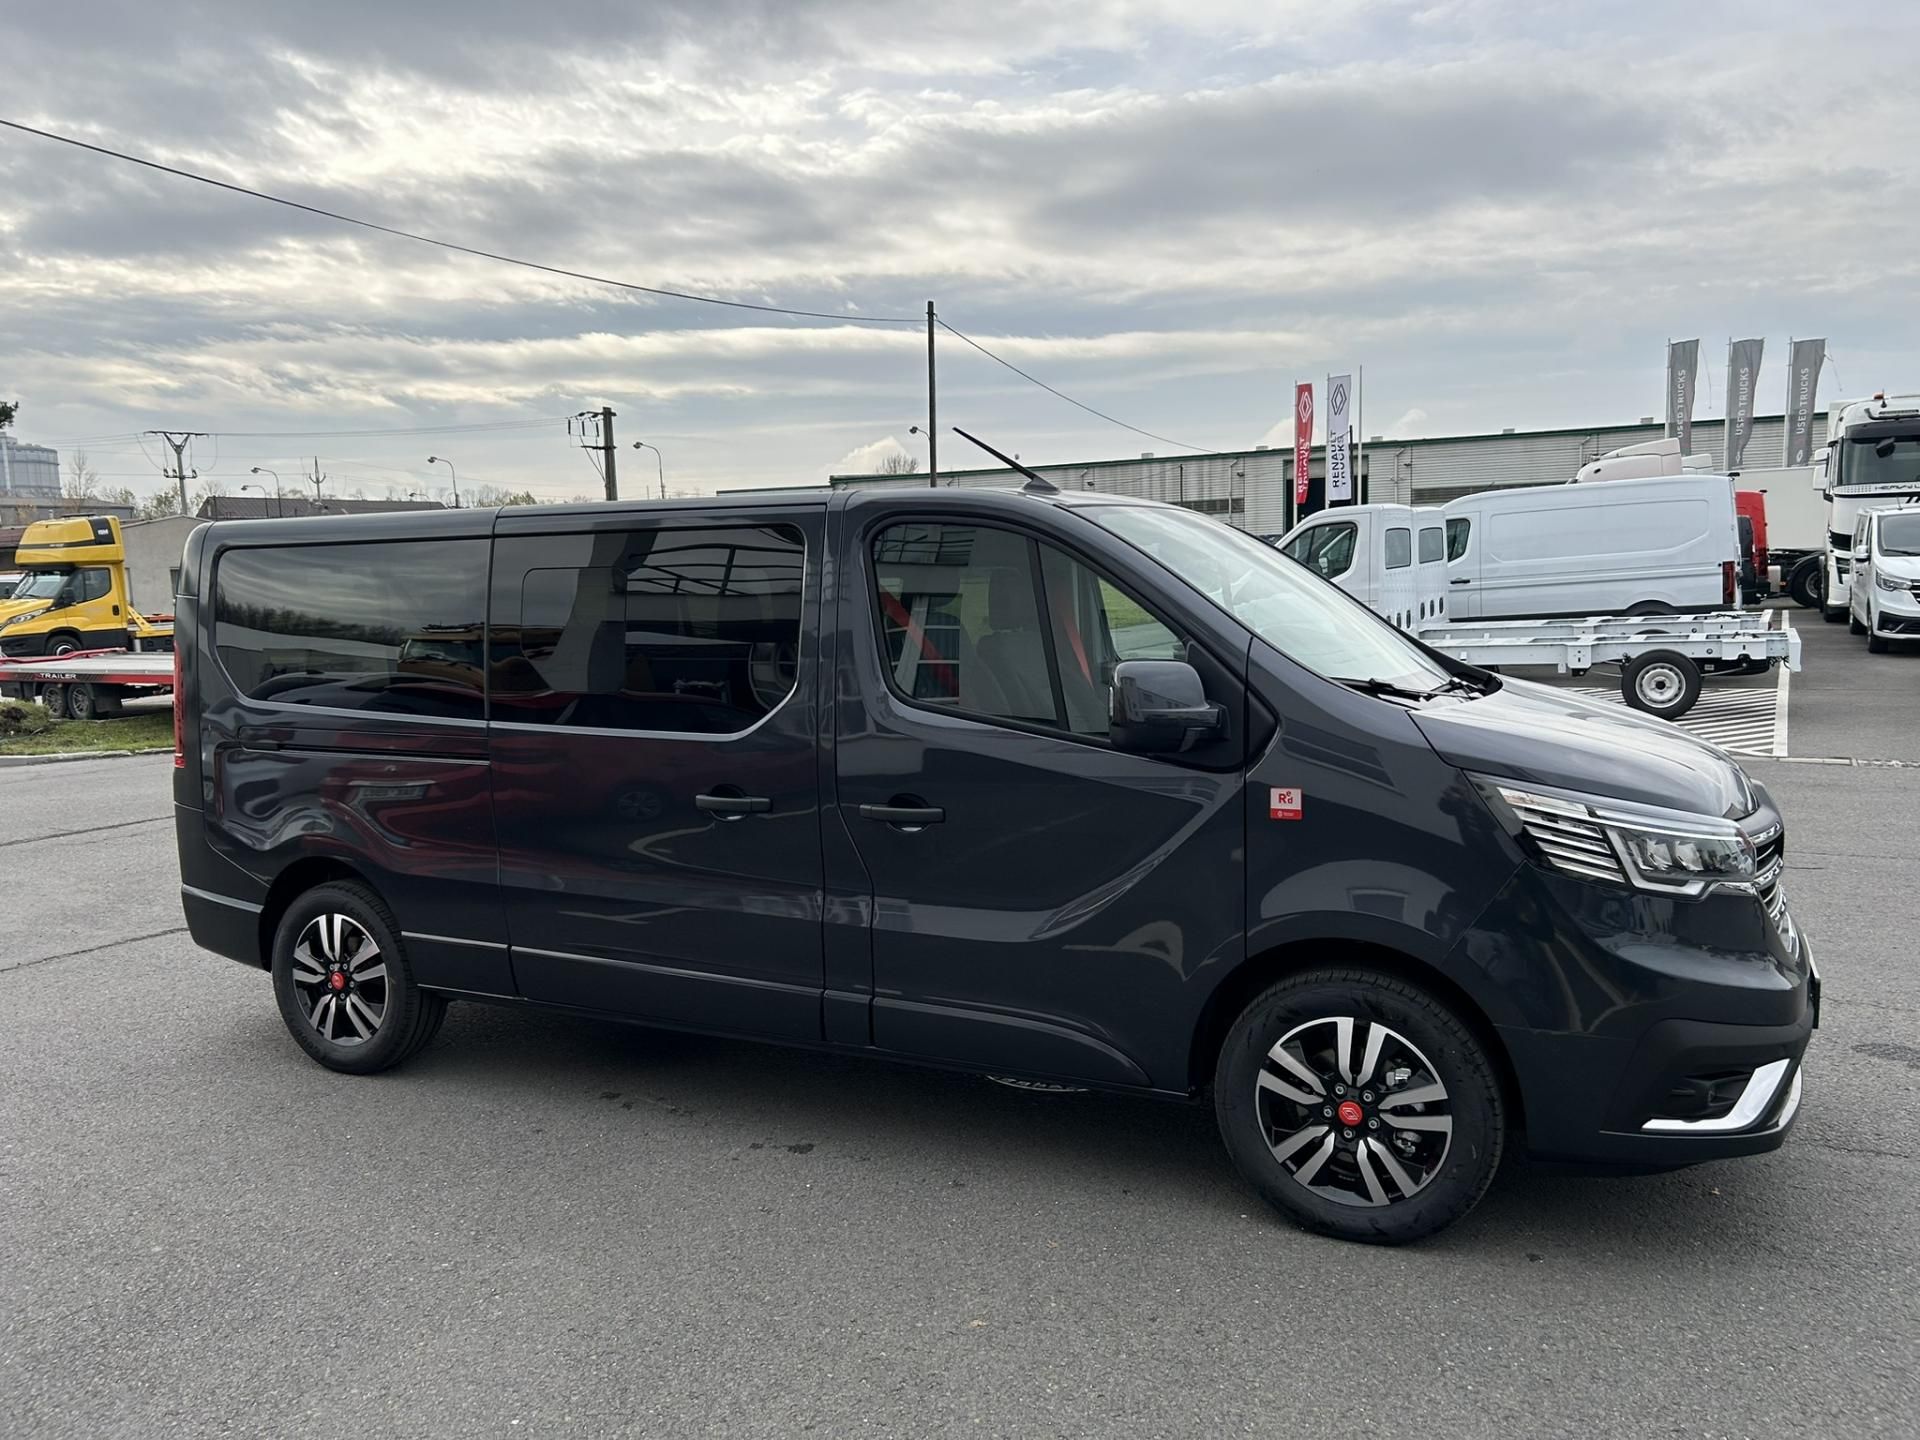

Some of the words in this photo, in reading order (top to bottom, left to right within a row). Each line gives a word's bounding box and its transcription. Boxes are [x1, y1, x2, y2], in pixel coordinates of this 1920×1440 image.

[1677, 369, 1686, 410] TRUCKS
[1739, 367, 1749, 408] TRUCKS
[1799, 367, 1809, 407] TRUCKS
[1796, 408, 1807, 434] USED
[1330, 430, 1340, 488] RENAULT
